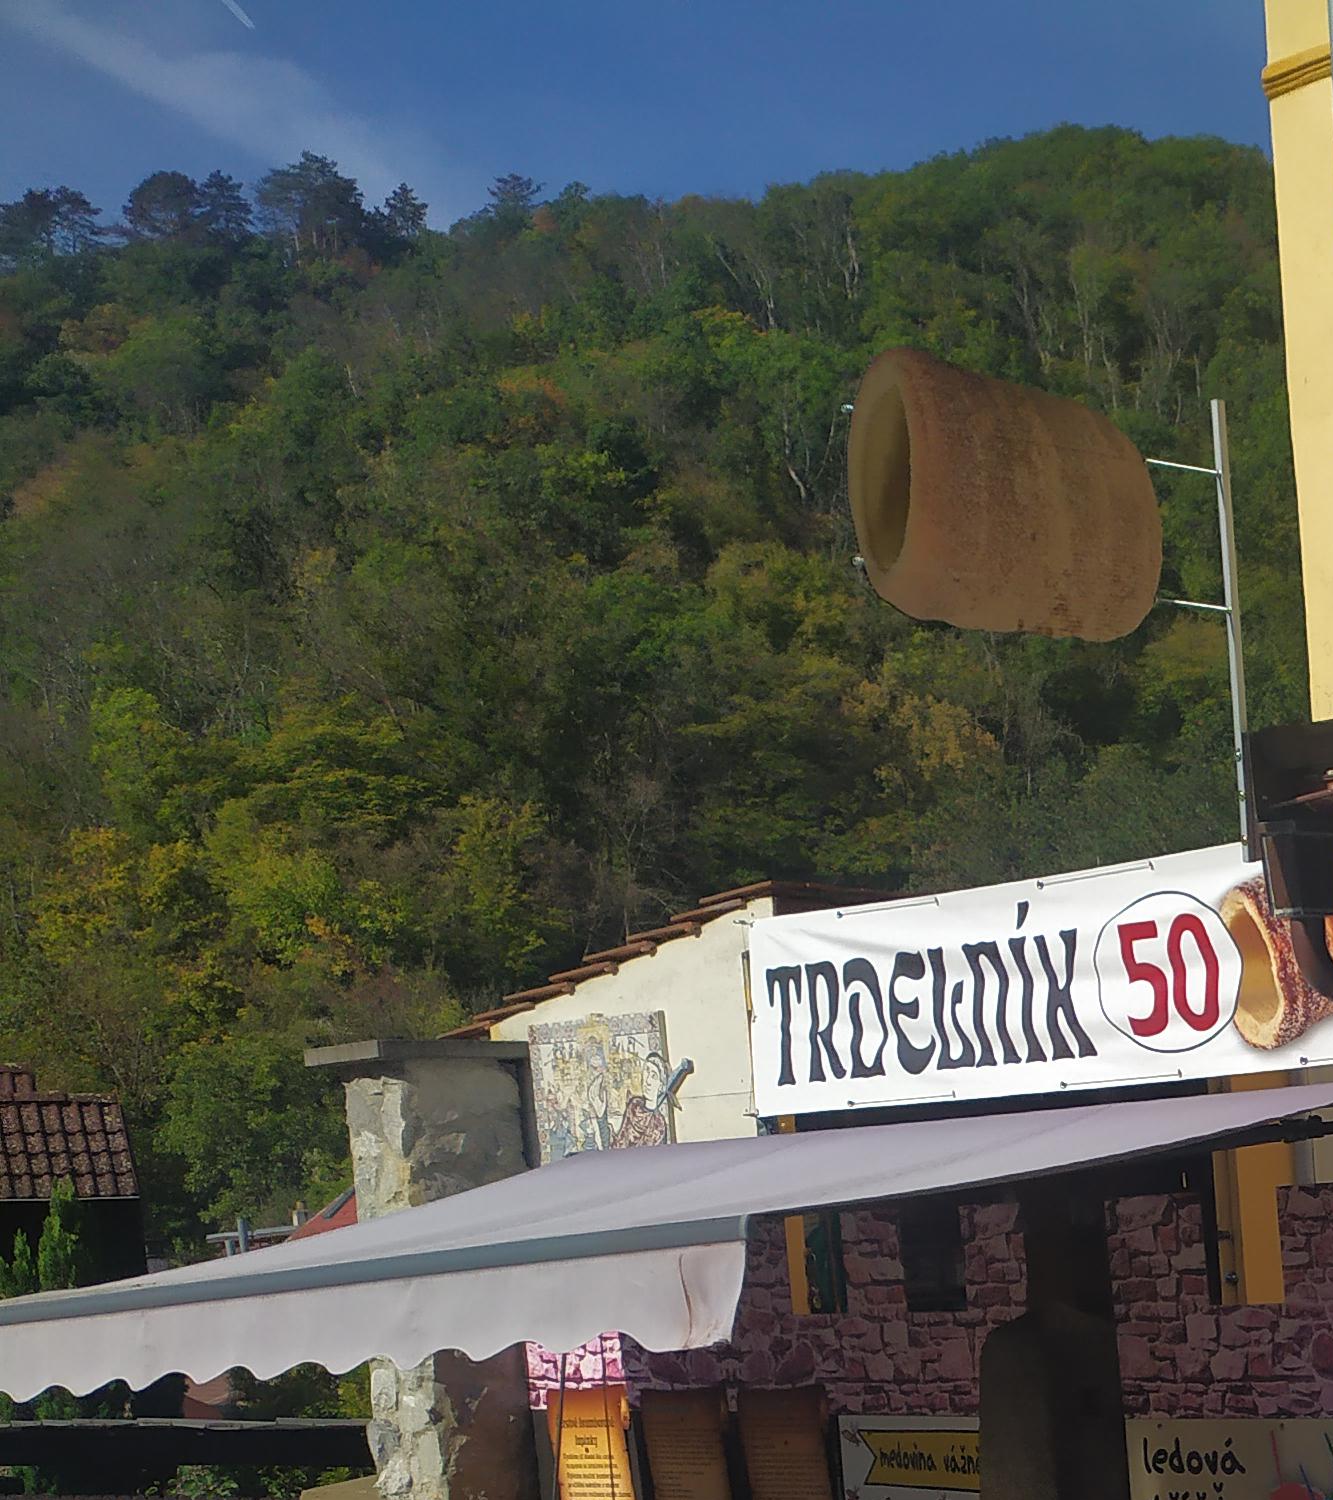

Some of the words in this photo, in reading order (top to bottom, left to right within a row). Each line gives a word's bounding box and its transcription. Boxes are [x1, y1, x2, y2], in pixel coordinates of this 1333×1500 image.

[1117, 912, 1220, 1037] 50
[879, 1444, 938, 1474] medovina
[1142, 1436, 1247, 1476] ledová
